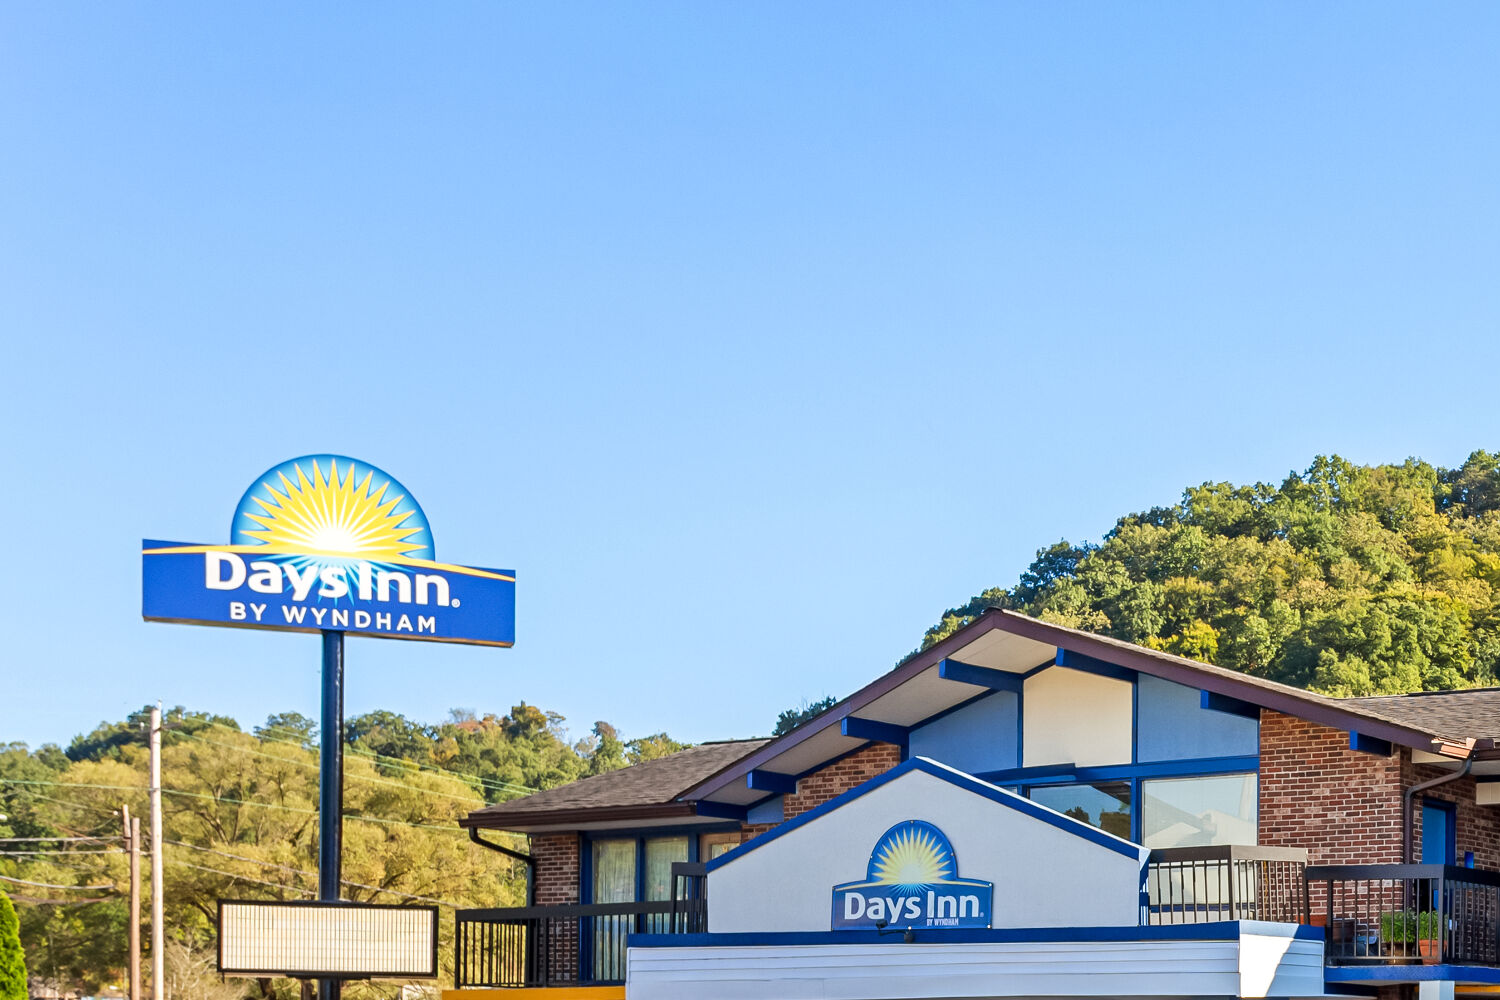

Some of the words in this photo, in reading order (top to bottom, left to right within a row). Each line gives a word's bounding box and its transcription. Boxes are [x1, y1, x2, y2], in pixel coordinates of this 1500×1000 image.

[205, 551, 349, 601] Days
[358, 561, 450, 607] Inn
[229, 602, 267, 622] BY
[282, 605, 436, 633] WYNDHAM
[844, 892, 921, 924] Days
[926, 891, 980, 918] Inn
